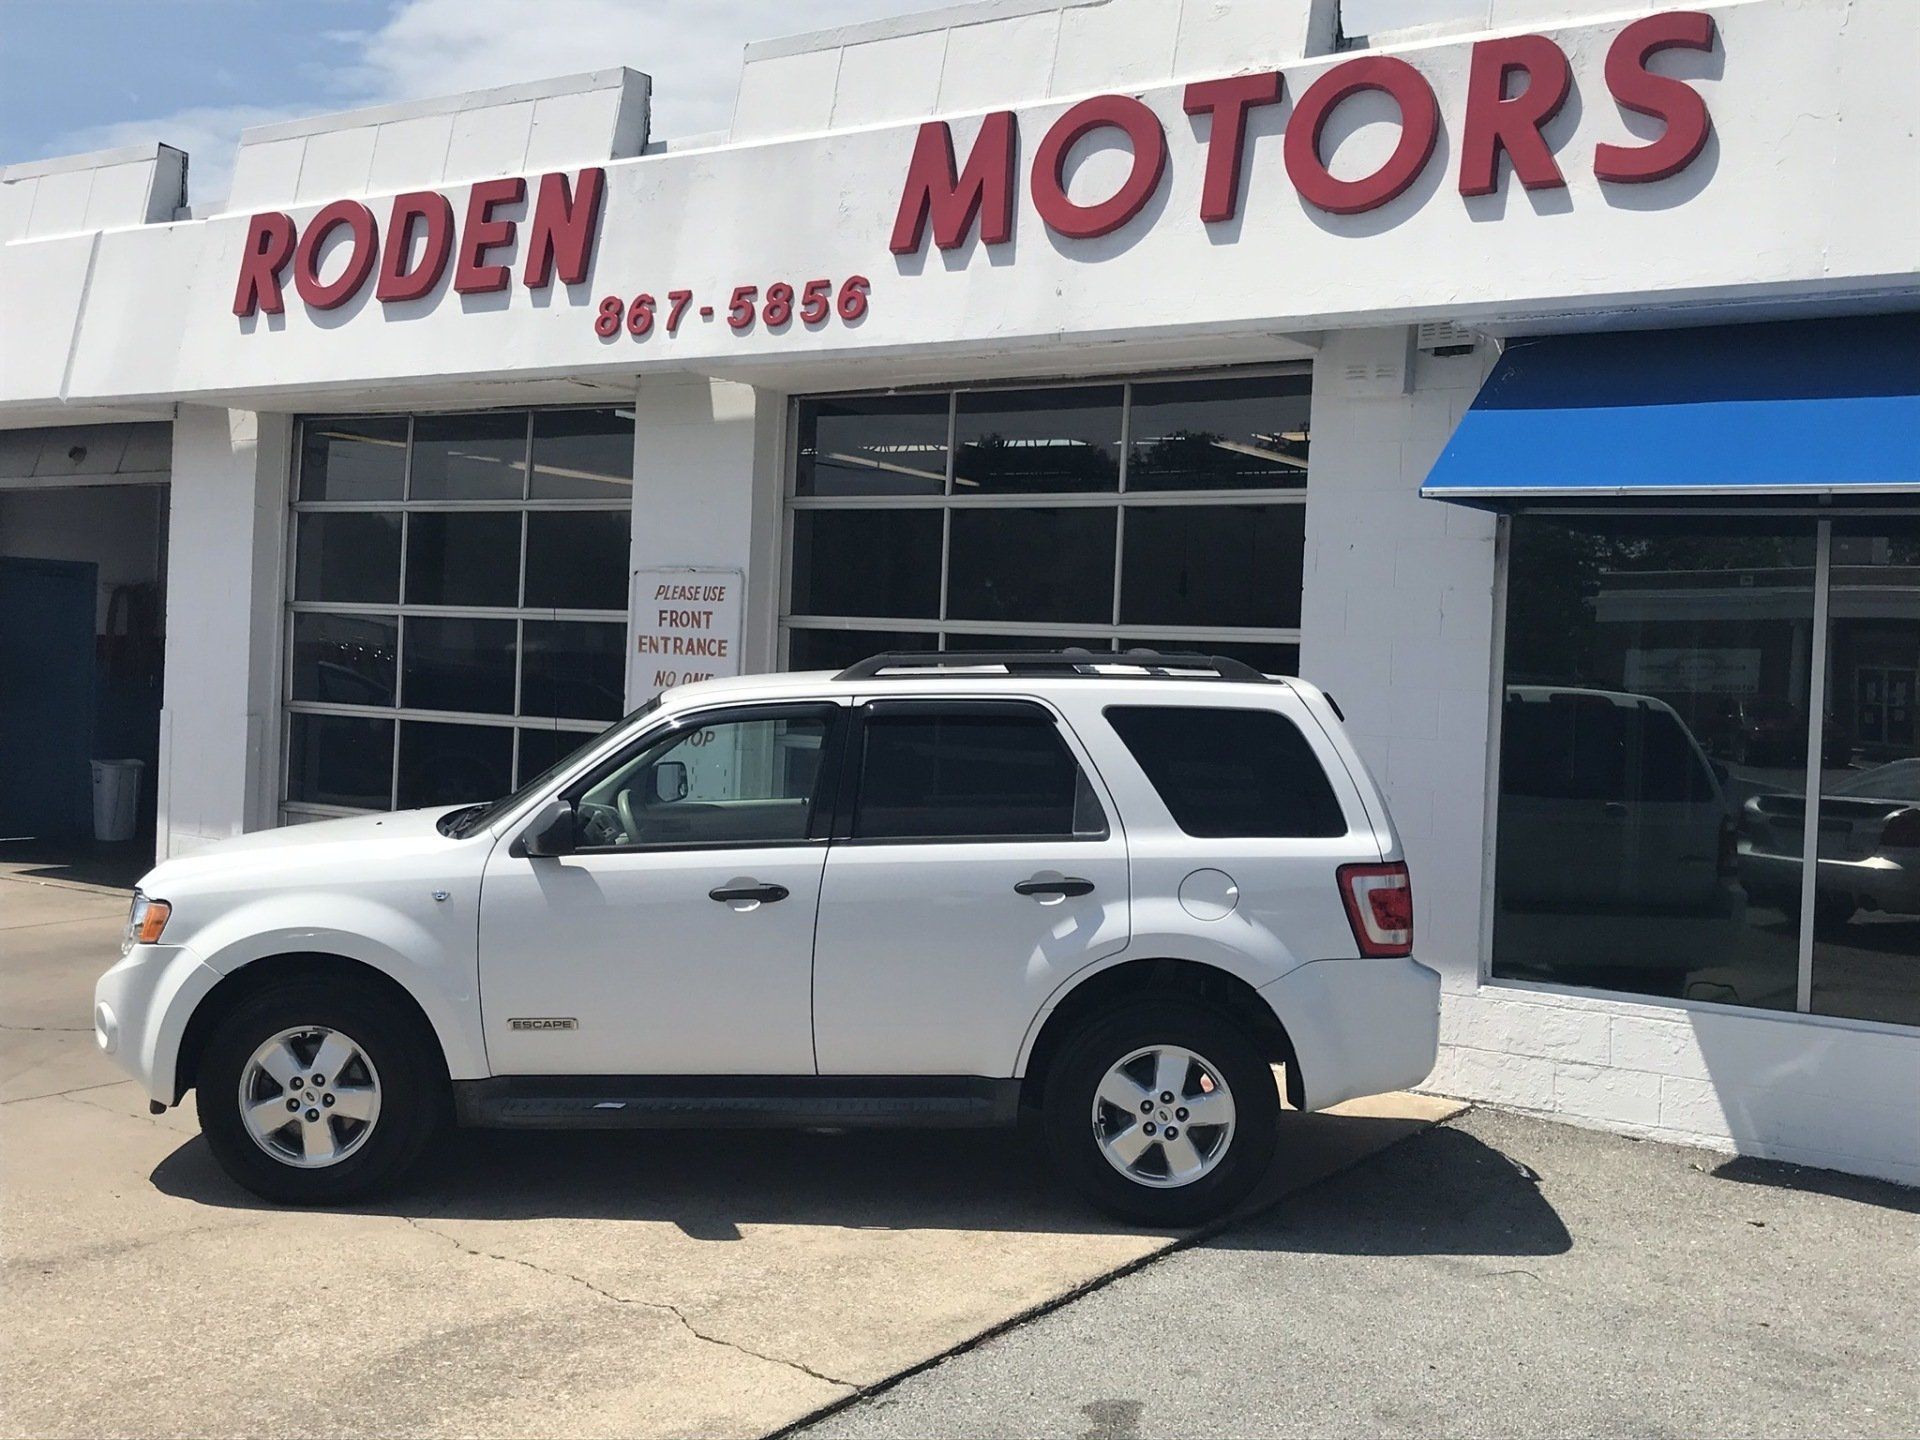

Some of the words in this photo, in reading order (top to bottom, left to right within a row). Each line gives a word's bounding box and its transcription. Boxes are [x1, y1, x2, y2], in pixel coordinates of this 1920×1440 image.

[233, 167, 605, 317] RODEN
[889, 10, 1717, 255] MOTORS
[595, 275, 870, 337] 867-5856
[654, 585, 701, 601] PLEASE
[703, 586, 726, 602] USE
[658, 610, 713, 629] FRONT
[638, 635, 728, 657] ENTRANCE
[653, 670, 677, 687] NO
[513, 1020, 572, 1030] ESCAPE
